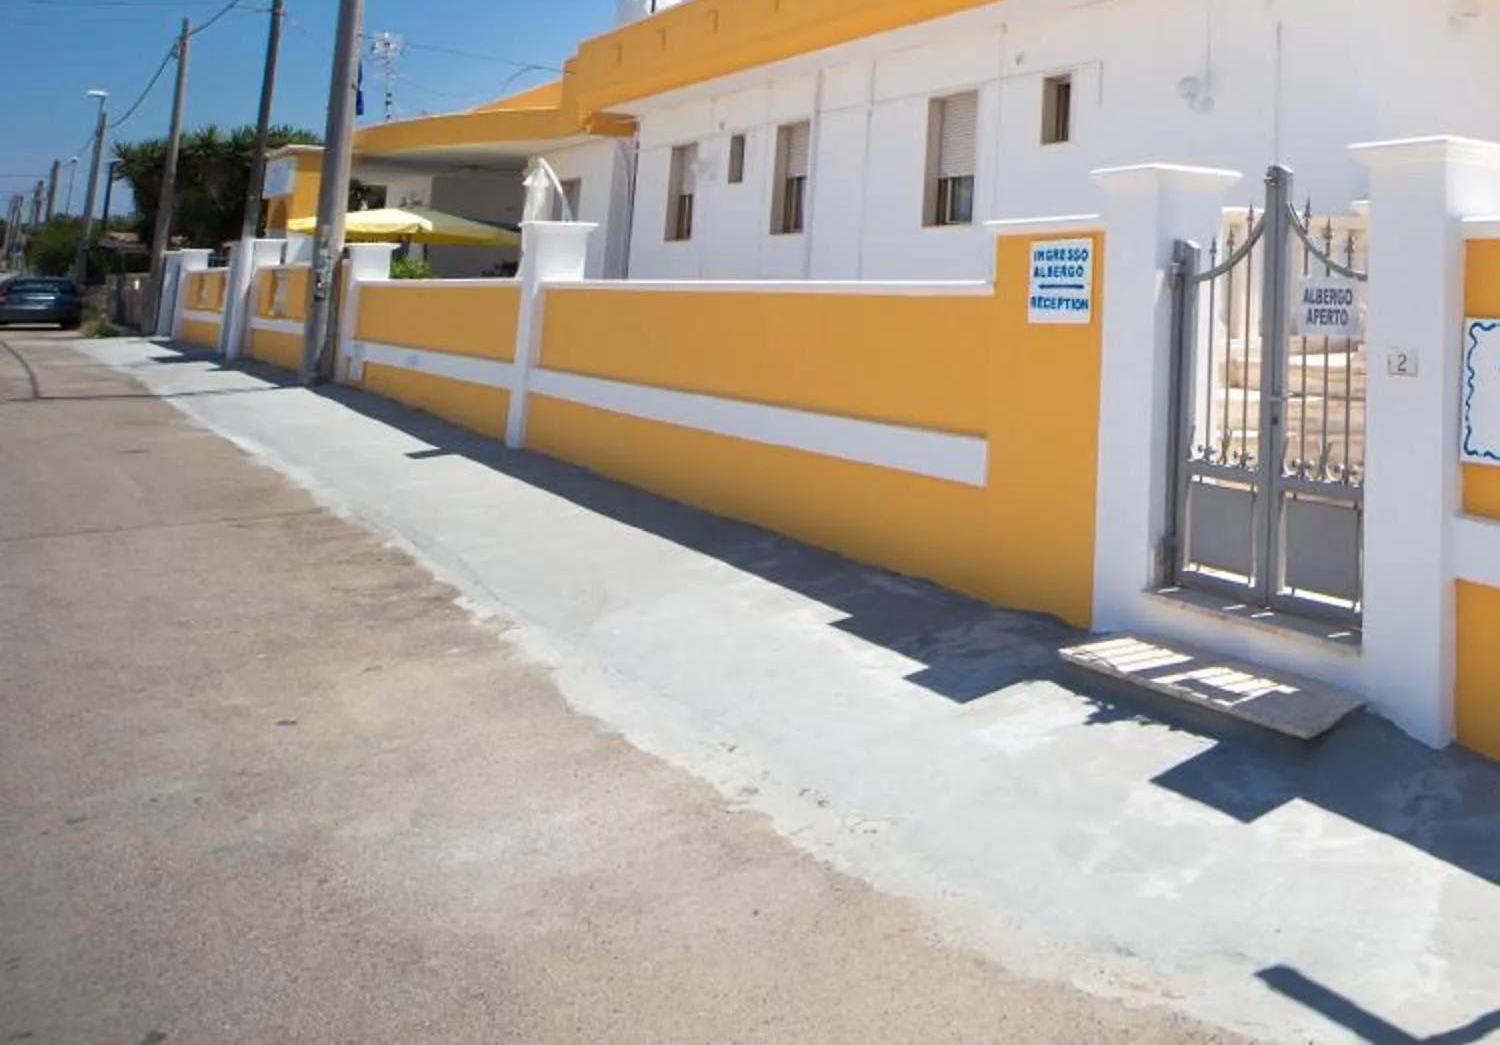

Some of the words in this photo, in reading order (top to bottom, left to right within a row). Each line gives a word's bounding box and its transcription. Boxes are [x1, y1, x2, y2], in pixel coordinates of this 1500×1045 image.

[1033, 249, 1089, 262] INGRESSO
[1033, 266, 1084, 278] ALBERGO
[1031, 296, 1089, 310] RECEPTION
[1303, 288, 1353, 305] ALBERGO
[1305, 308, 1349, 326] APERTO
[1396, 353, 1407, 372] 2
